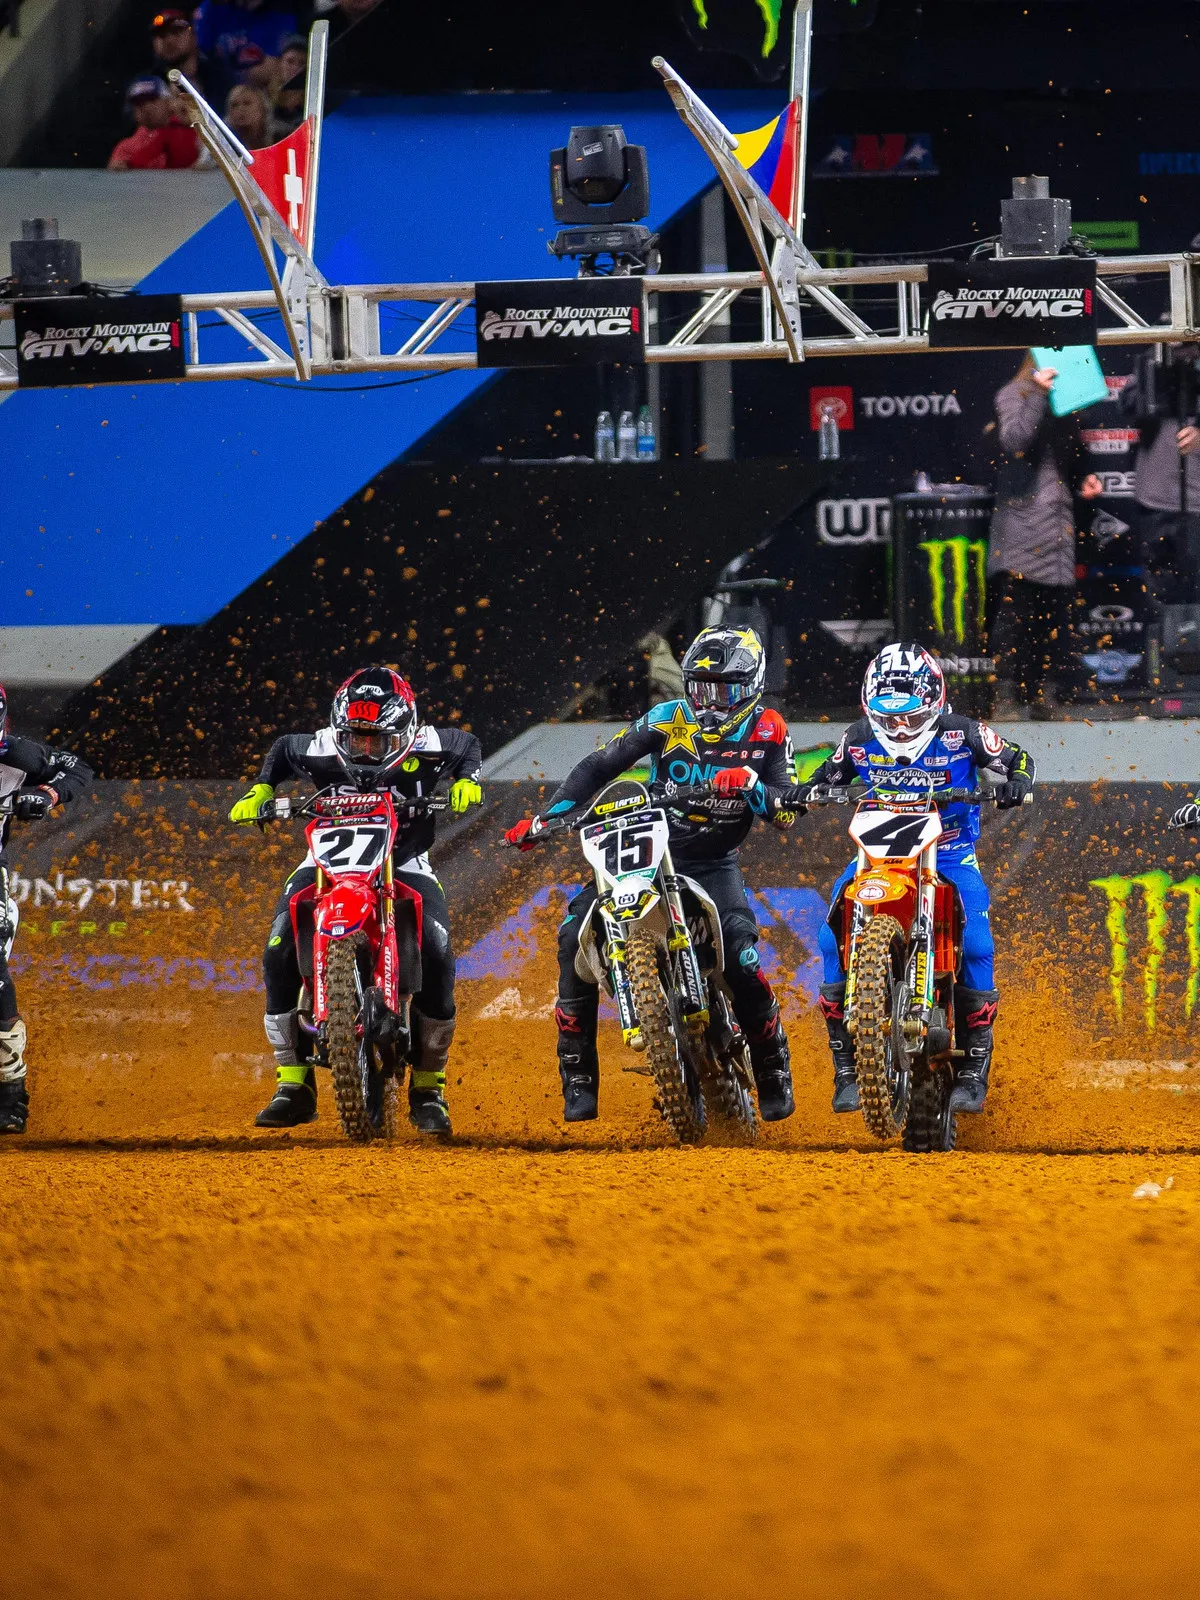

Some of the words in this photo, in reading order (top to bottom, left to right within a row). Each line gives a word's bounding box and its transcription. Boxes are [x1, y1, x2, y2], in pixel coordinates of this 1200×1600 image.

[957, 288, 1003, 300] ROCKY
[1005, 287, 1084, 300] MOUNTAIN
[504, 308, 551, 321] ROCKY
[553, 306, 630, 319] MOUNTAIN
[44, 327, 91, 340] ROCKY
[93, 322, 170, 337] MOUNTAIN
[861, 394, 962, 417] TOYOTA
[906, 769, 946, 778] MOUNTAIN
[688, 795, 747, 809] usqvarna
[319, 828, 387, 867] 27
[598, 824, 654, 879] 15
[859, 815, 930, 857] 4
[9, 871, 195, 912] ONSTER
[384, 946, 392, 998] DUNLOP
[915, 951, 927, 995] GALFER
